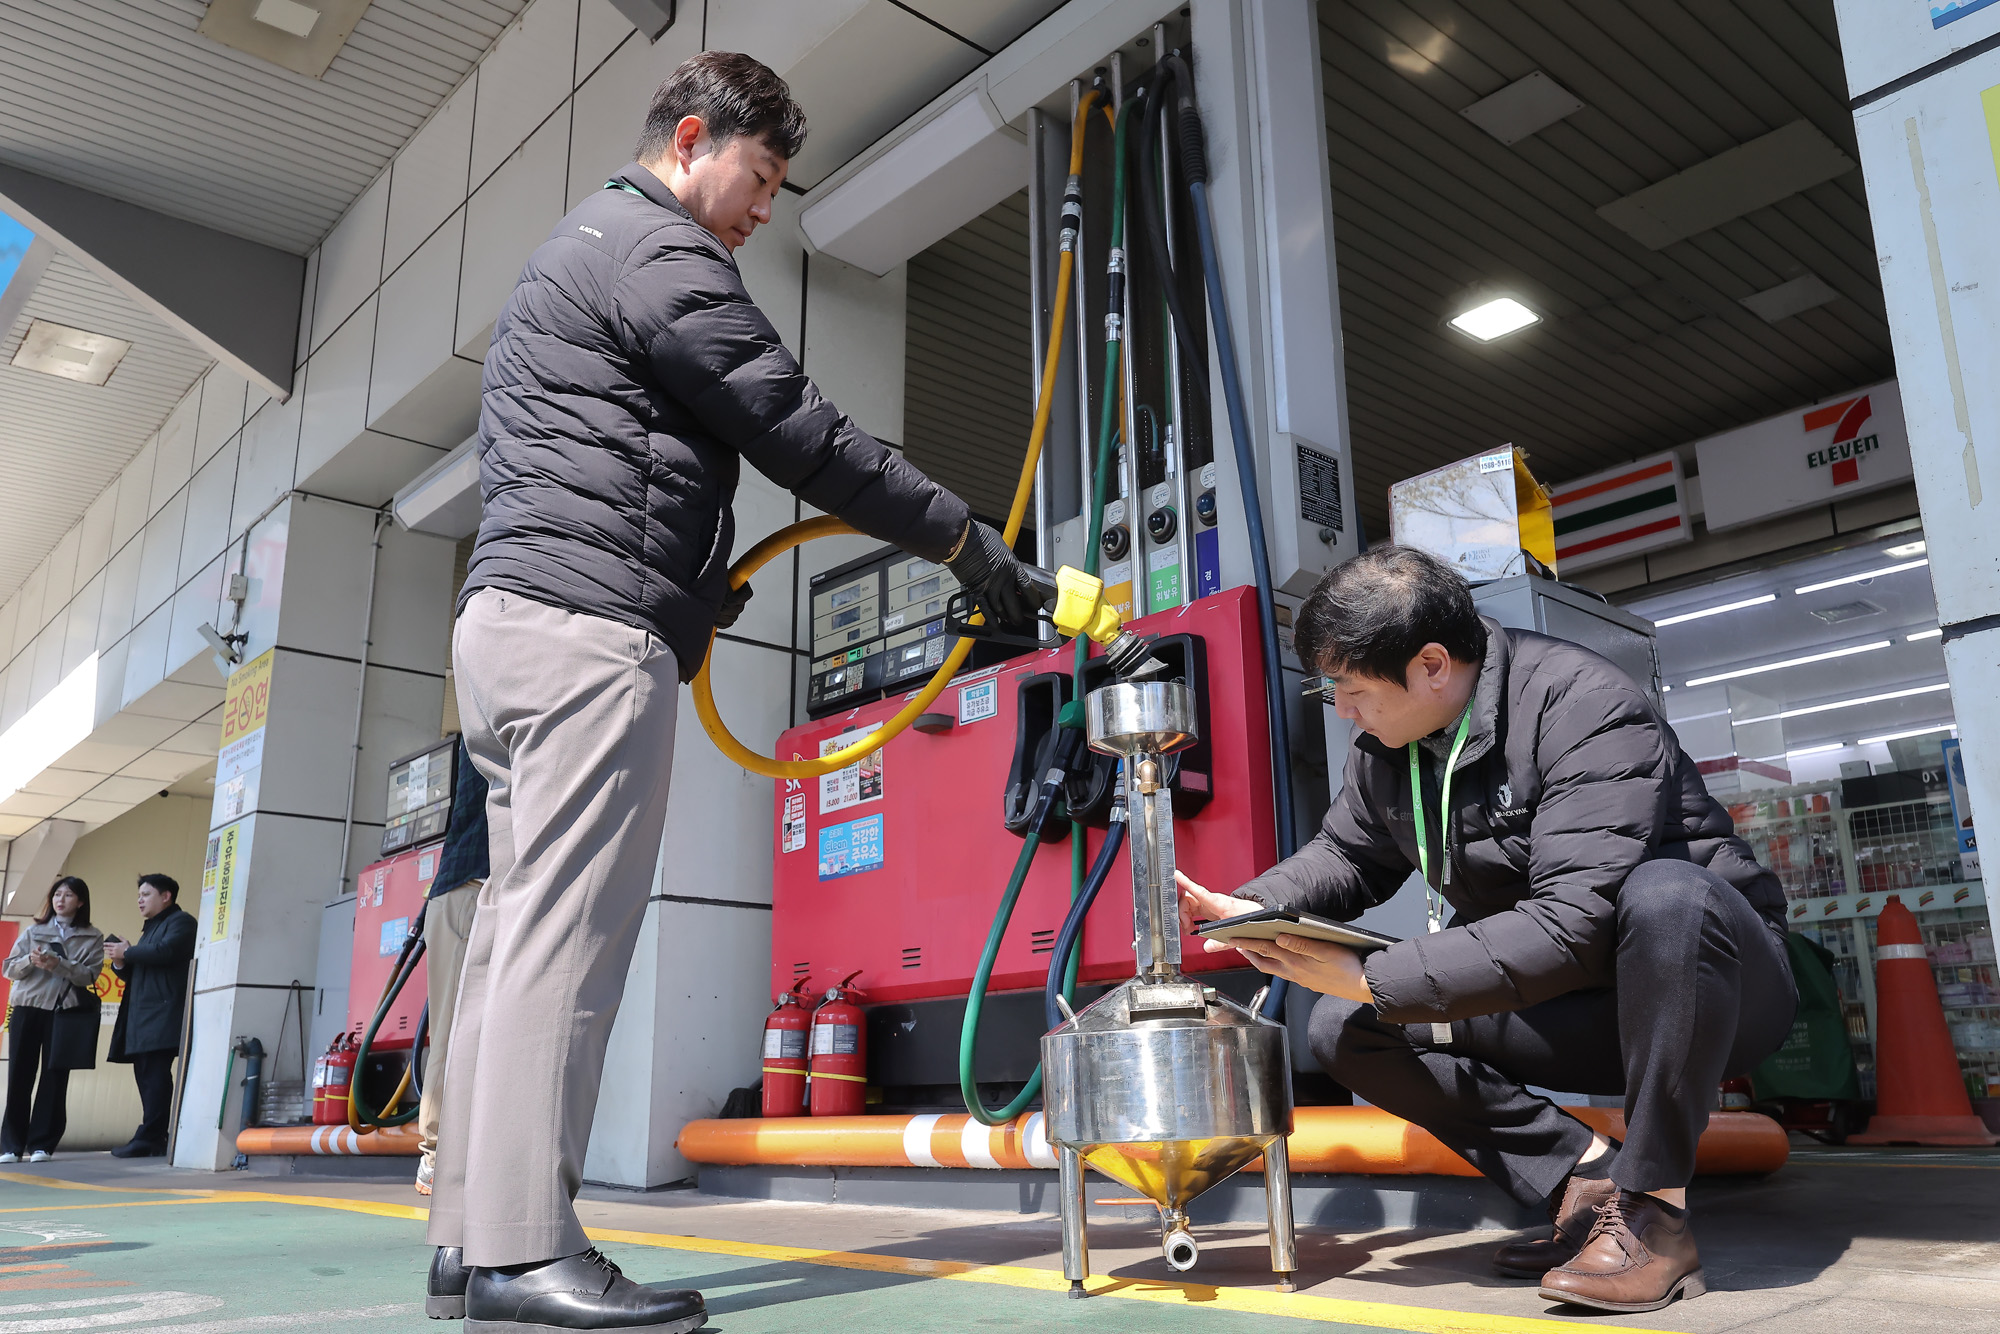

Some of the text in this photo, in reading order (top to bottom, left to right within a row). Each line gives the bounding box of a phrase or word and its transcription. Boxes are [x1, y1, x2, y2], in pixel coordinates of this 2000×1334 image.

[1156, 587, 1178, 602] 휘발유
[852, 826, 879, 846] 건강한
[824, 839, 847, 854] Clean
[851, 843, 878, 862] 주유소
